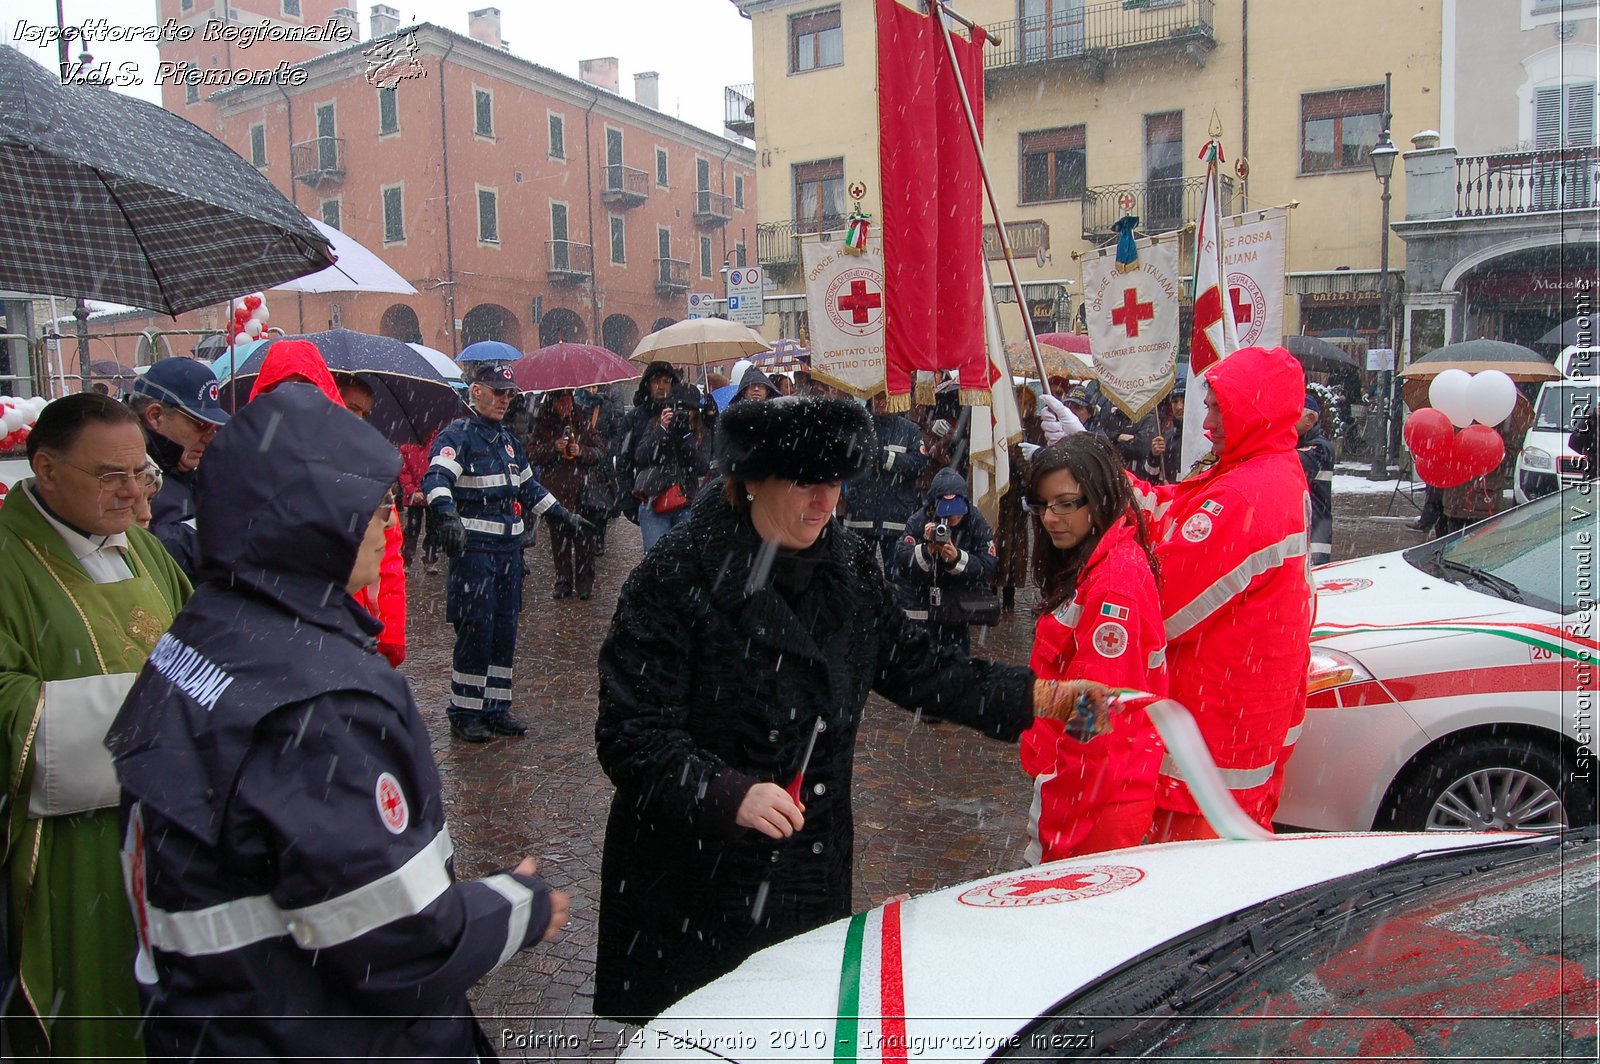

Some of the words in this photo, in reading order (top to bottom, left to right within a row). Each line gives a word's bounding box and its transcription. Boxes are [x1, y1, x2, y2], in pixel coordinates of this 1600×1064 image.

[1238, 230, 1273, 247] ROSSA
[808, 255, 835, 281] CROCE
[826, 281, 845, 328] CONVENZIONE
[844, 269, 875, 280] GINEVRA
[1093, 276, 1111, 312] CROCE
[1143, 263, 1175, 299] ITALIANA
[1252, 290, 1264, 328] AGOSTO
[823, 347, 865, 358] COMITATO
[1138, 341, 1171, 353] SOCCORSO
[818, 358, 859, 371] SETTIMO
[1104, 371, 1145, 390] FRANCESCO
[1148, 373, 1160, 385] AL
[165, 644, 235, 712] ITALIANA
